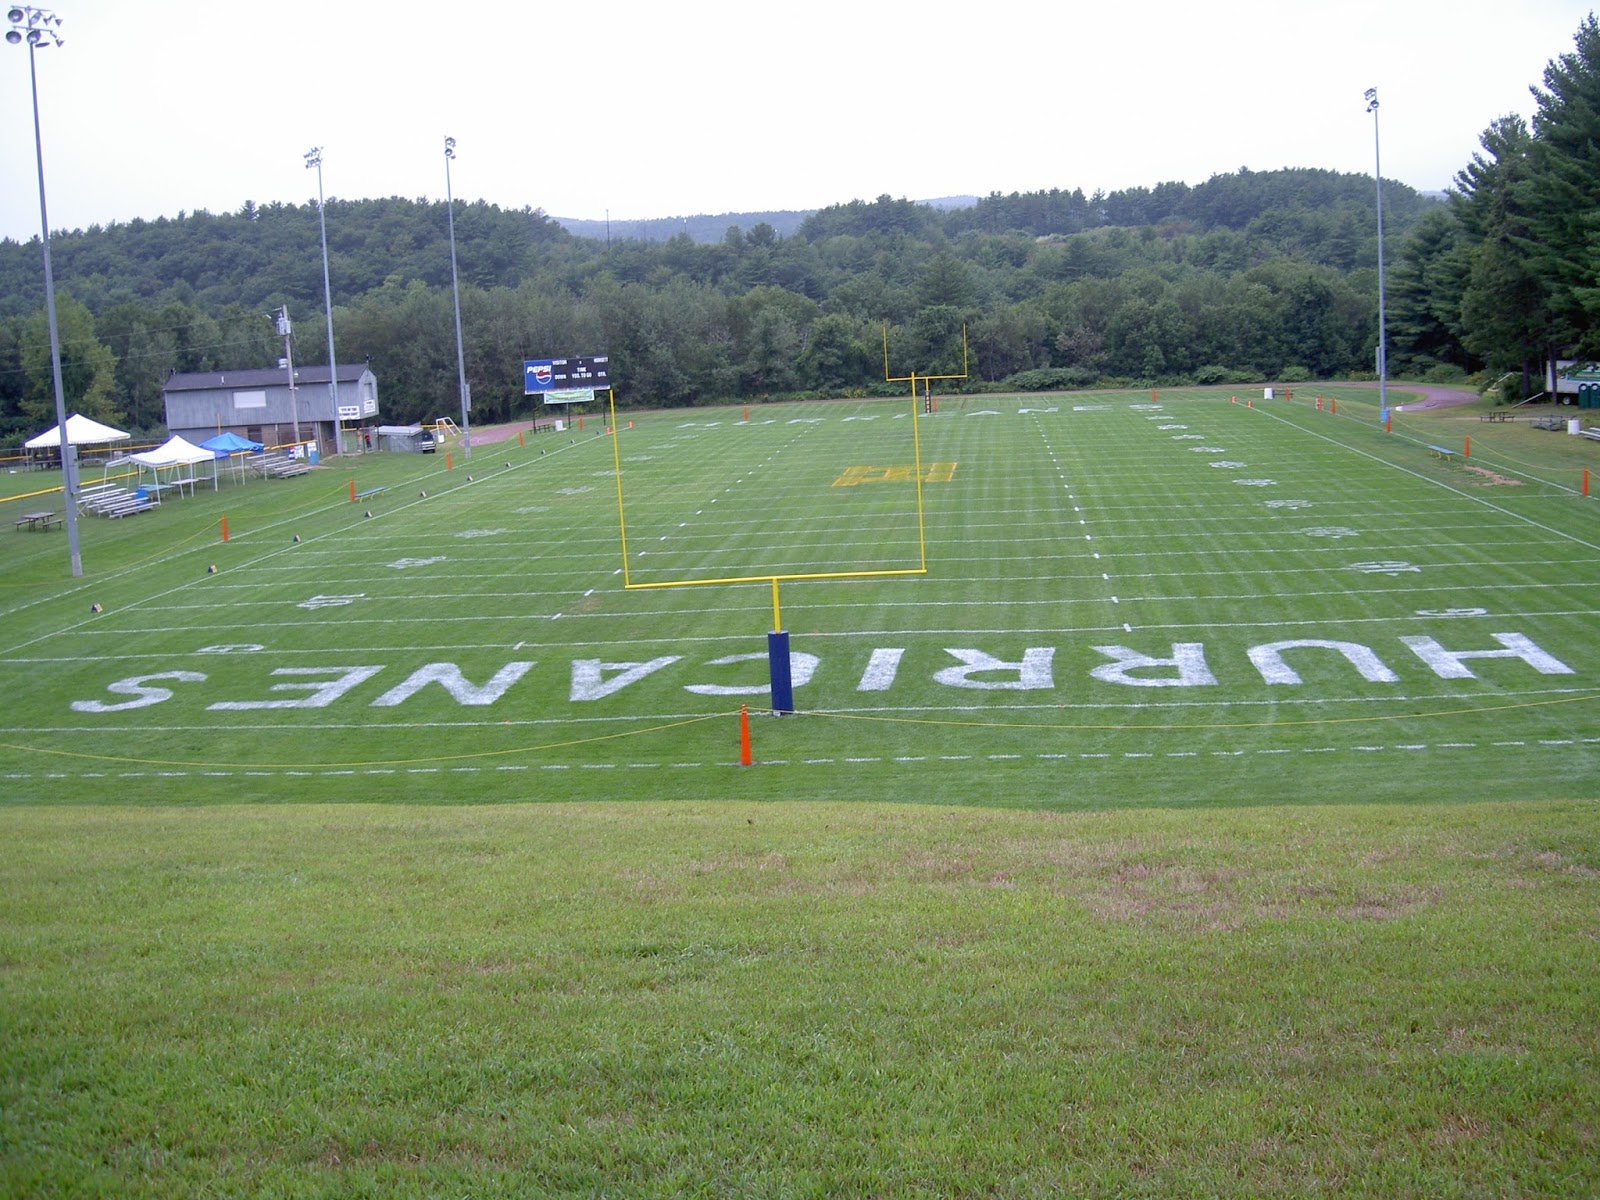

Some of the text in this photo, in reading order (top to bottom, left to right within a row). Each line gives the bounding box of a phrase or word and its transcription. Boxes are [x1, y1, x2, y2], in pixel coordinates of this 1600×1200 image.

[526, 365, 552, 373] PEPSI
[1350, 560, 1421, 573] 10
[296, 593, 366, 609] 10
[70, 632, 1575, 713] HURRICANES
